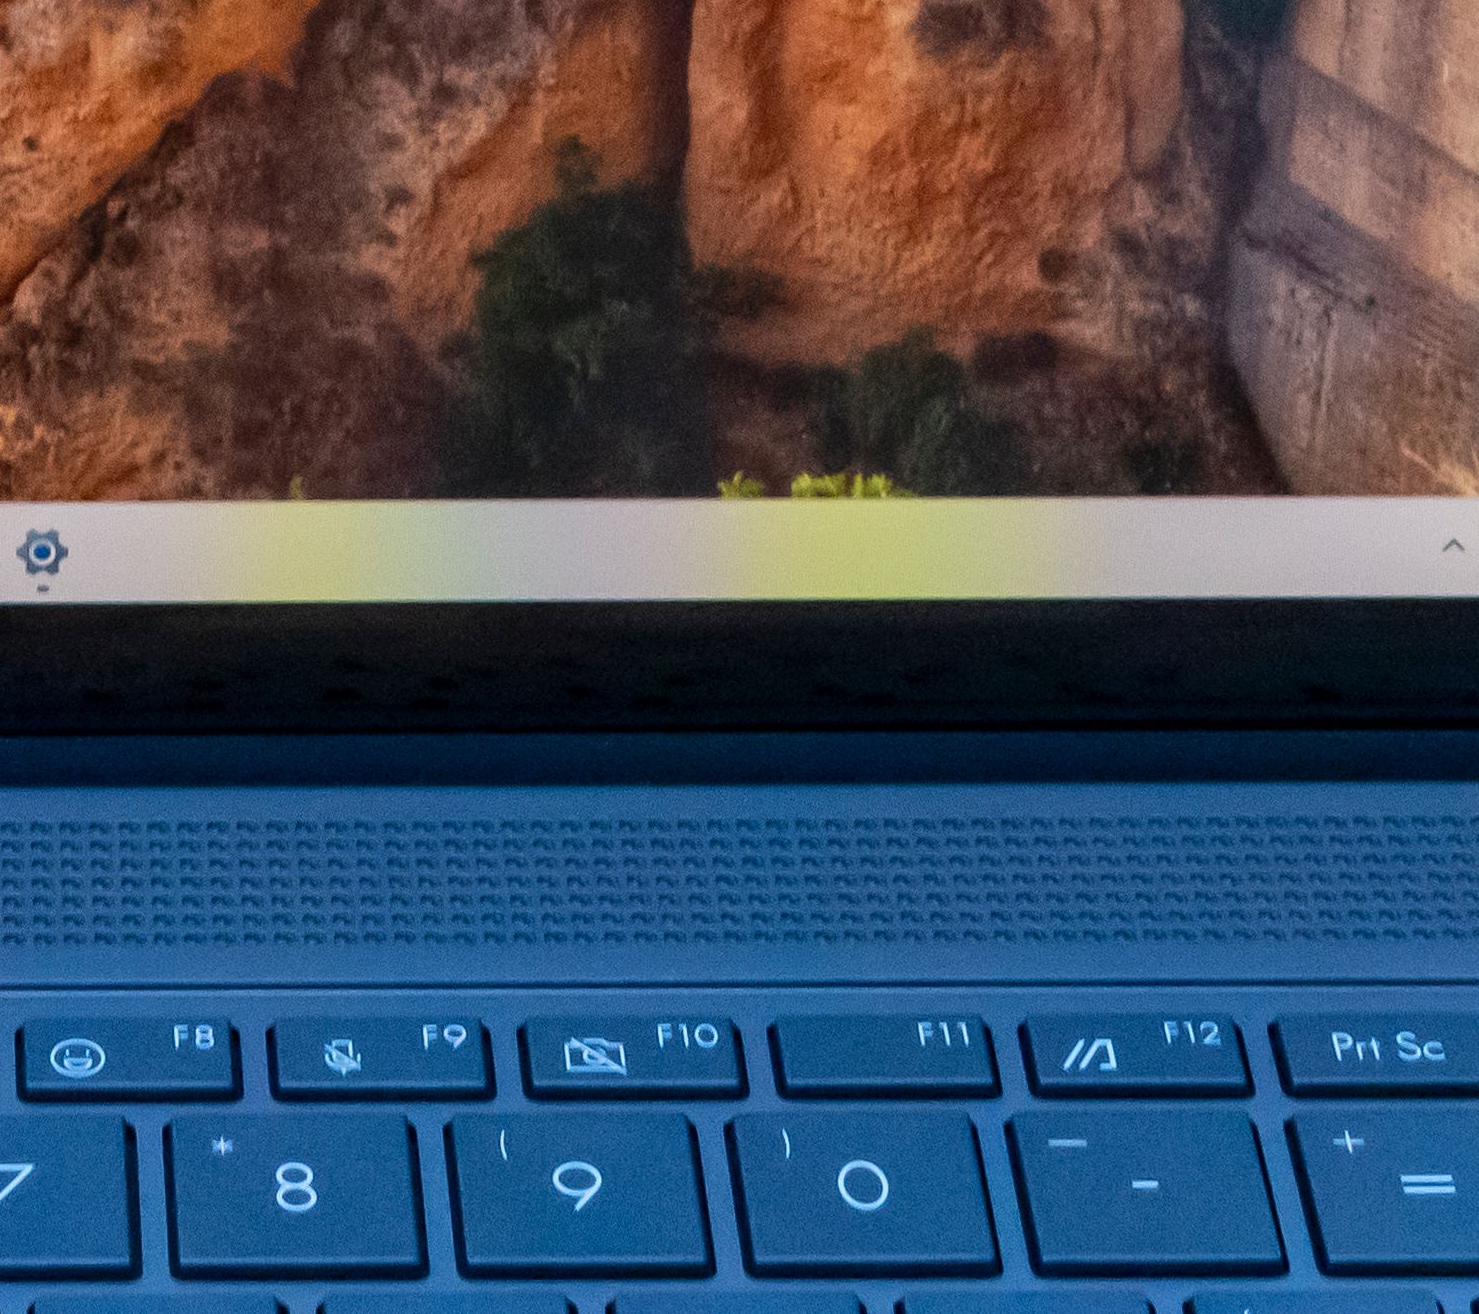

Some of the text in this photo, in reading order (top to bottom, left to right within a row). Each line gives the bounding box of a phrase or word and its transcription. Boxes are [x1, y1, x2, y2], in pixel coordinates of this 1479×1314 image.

[173, 1024, 215, 1049] F8
[422, 1024, 467, 1049] F9
[656, 1023, 719, 1048] F10
[917, 1021, 970, 1046] F11
[1163, 1021, 1221, 1045] F12
[1331, 1031, 1445, 1061] Prt Sc
[499, 1130, 508, 1161] (
[781, 1128, 791, 1159] )
[1334, 1130, 1364, 1154] +
[275, 1162, 318, 1212] 8
[552, 1161, 603, 1211] 9
[1401, 1174, 1456, 1194] =
